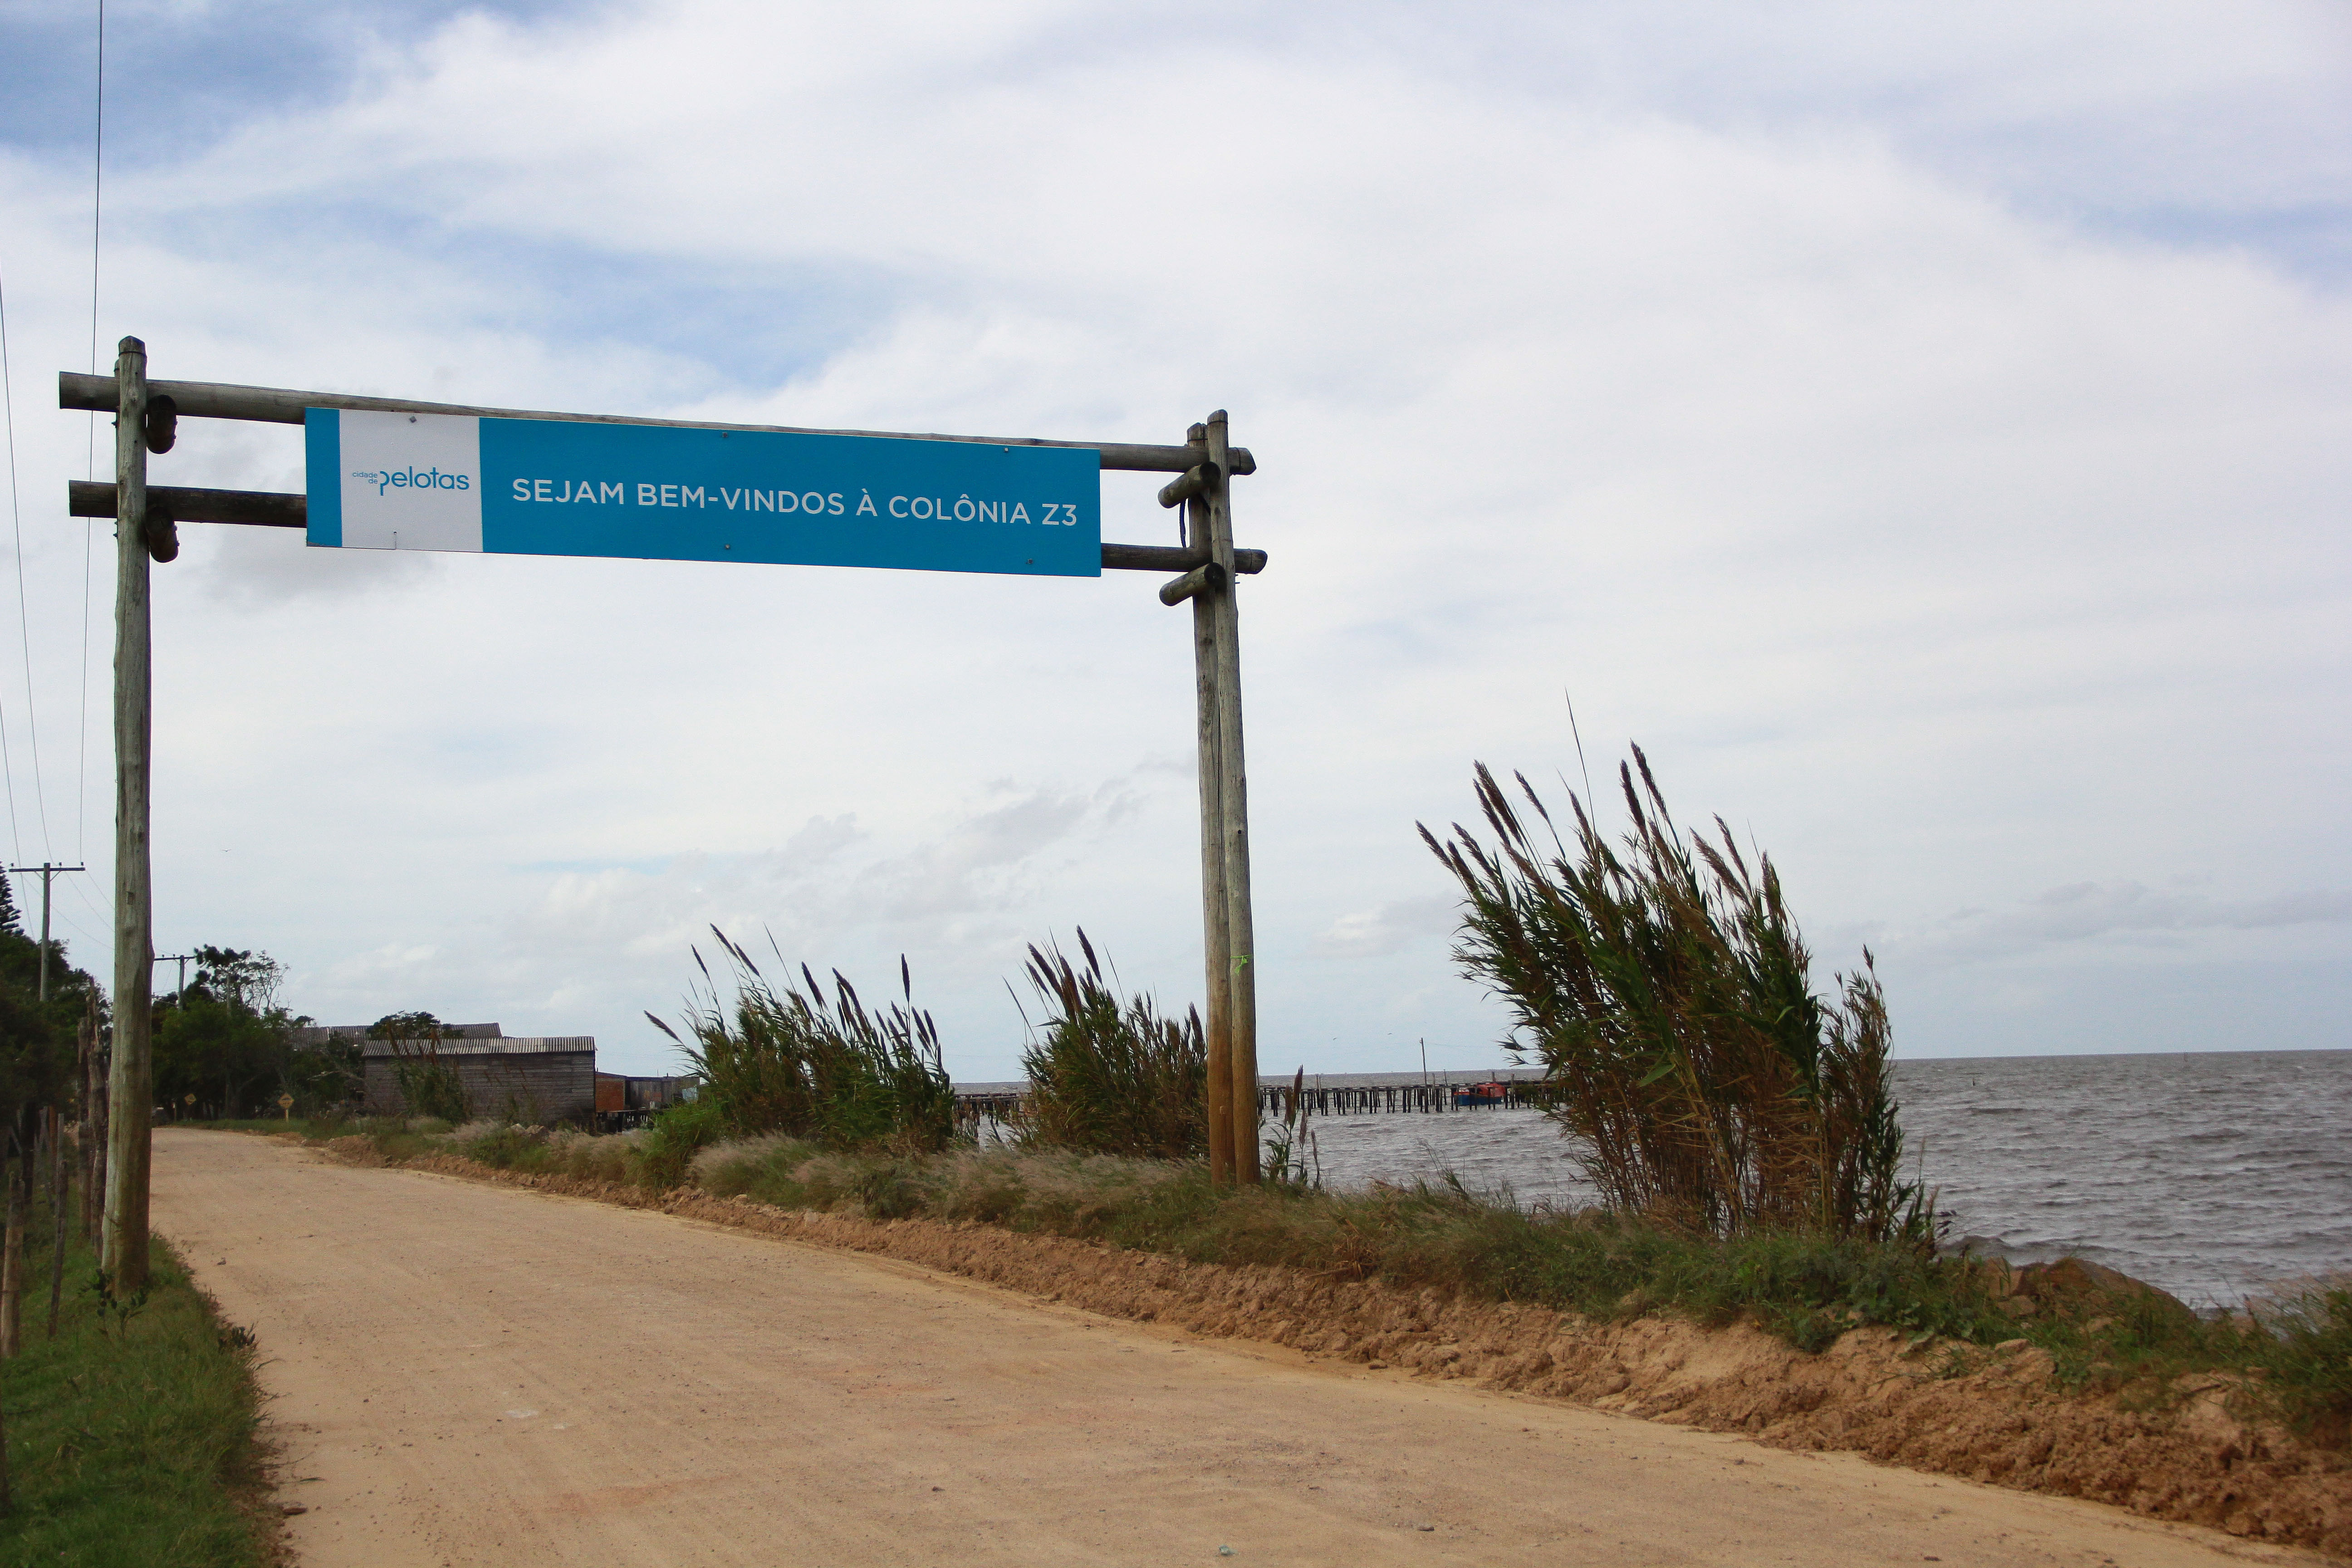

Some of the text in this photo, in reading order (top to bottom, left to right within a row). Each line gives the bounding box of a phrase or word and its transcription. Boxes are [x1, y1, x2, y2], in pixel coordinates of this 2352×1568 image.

[513, 478, 1077, 526] SEJAM BEM-VINDOS À COLÔNIA Z3
